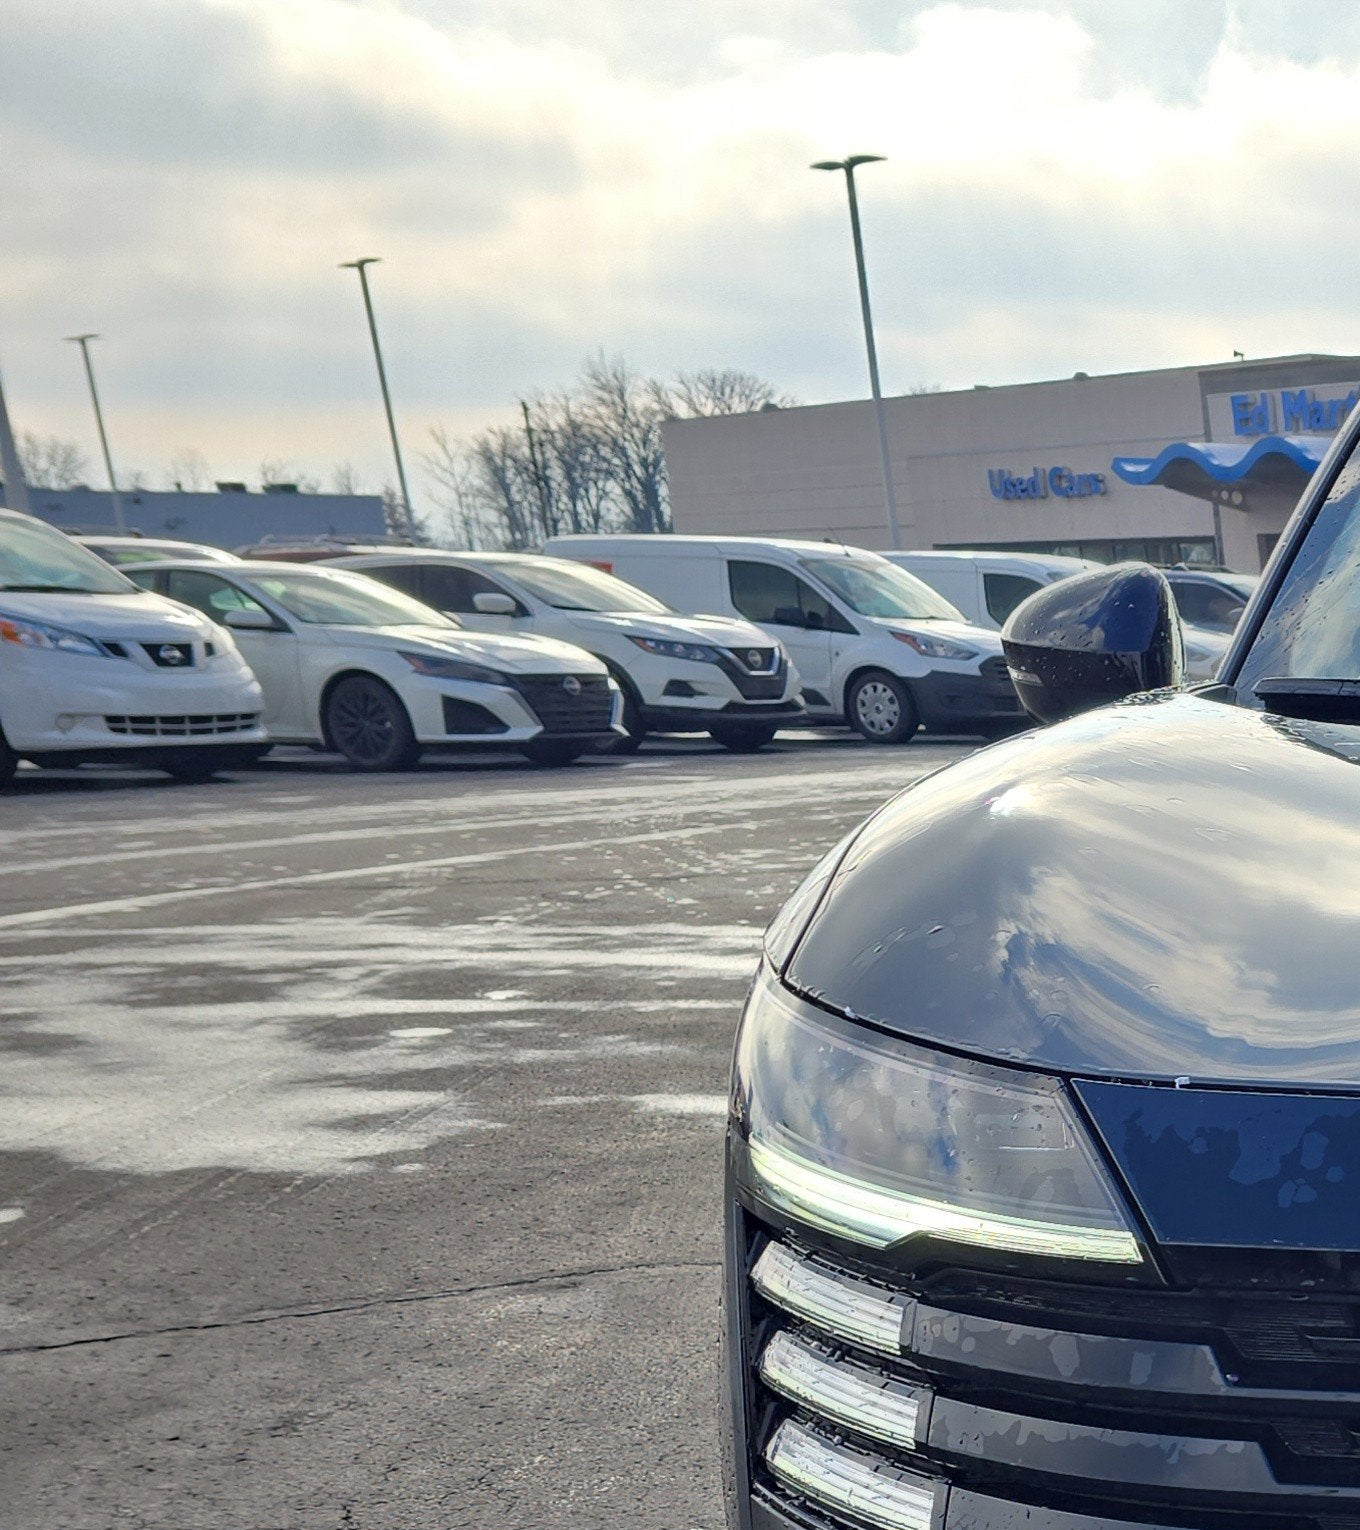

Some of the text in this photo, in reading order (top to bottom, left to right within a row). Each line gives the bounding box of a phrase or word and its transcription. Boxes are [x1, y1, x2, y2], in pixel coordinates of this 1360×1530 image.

[1231, 393, 1270, 436] Ed
[988, 465, 1106, 499] Used Cars
